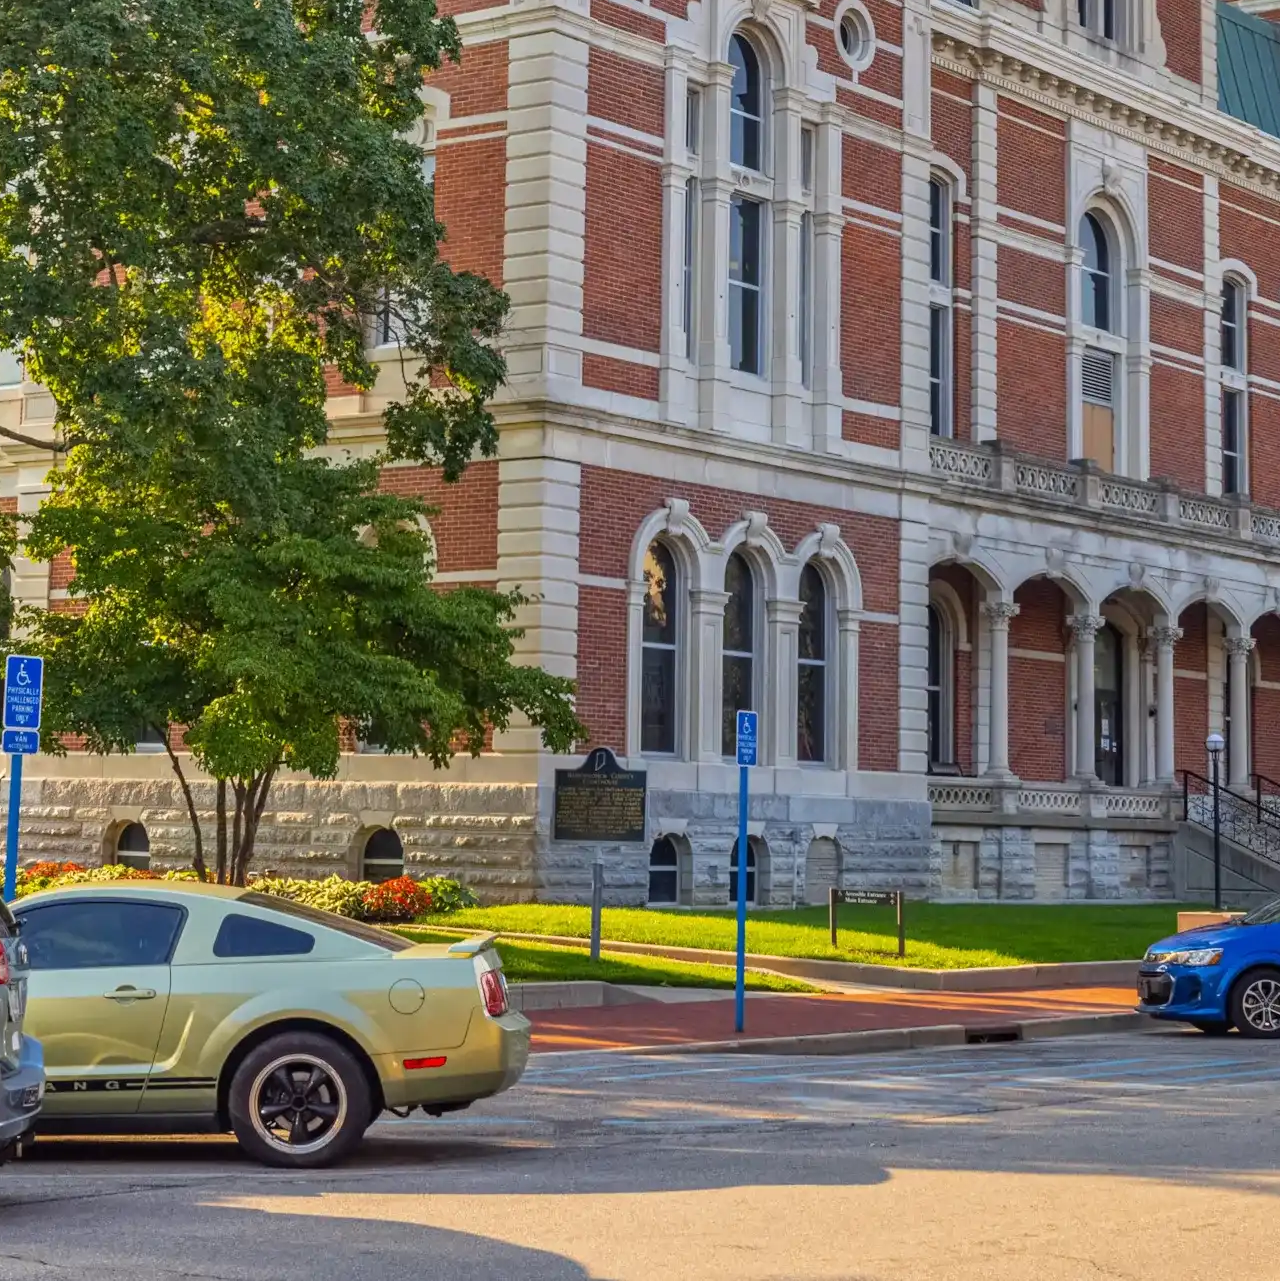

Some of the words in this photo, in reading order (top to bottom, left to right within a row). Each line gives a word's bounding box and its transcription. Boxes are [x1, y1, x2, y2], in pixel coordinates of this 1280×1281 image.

[8, 686, 39, 695] PHYSICALLY
[8, 695, 39, 704] CHALLENGED
[12, 705, 34, 713] PARKING
